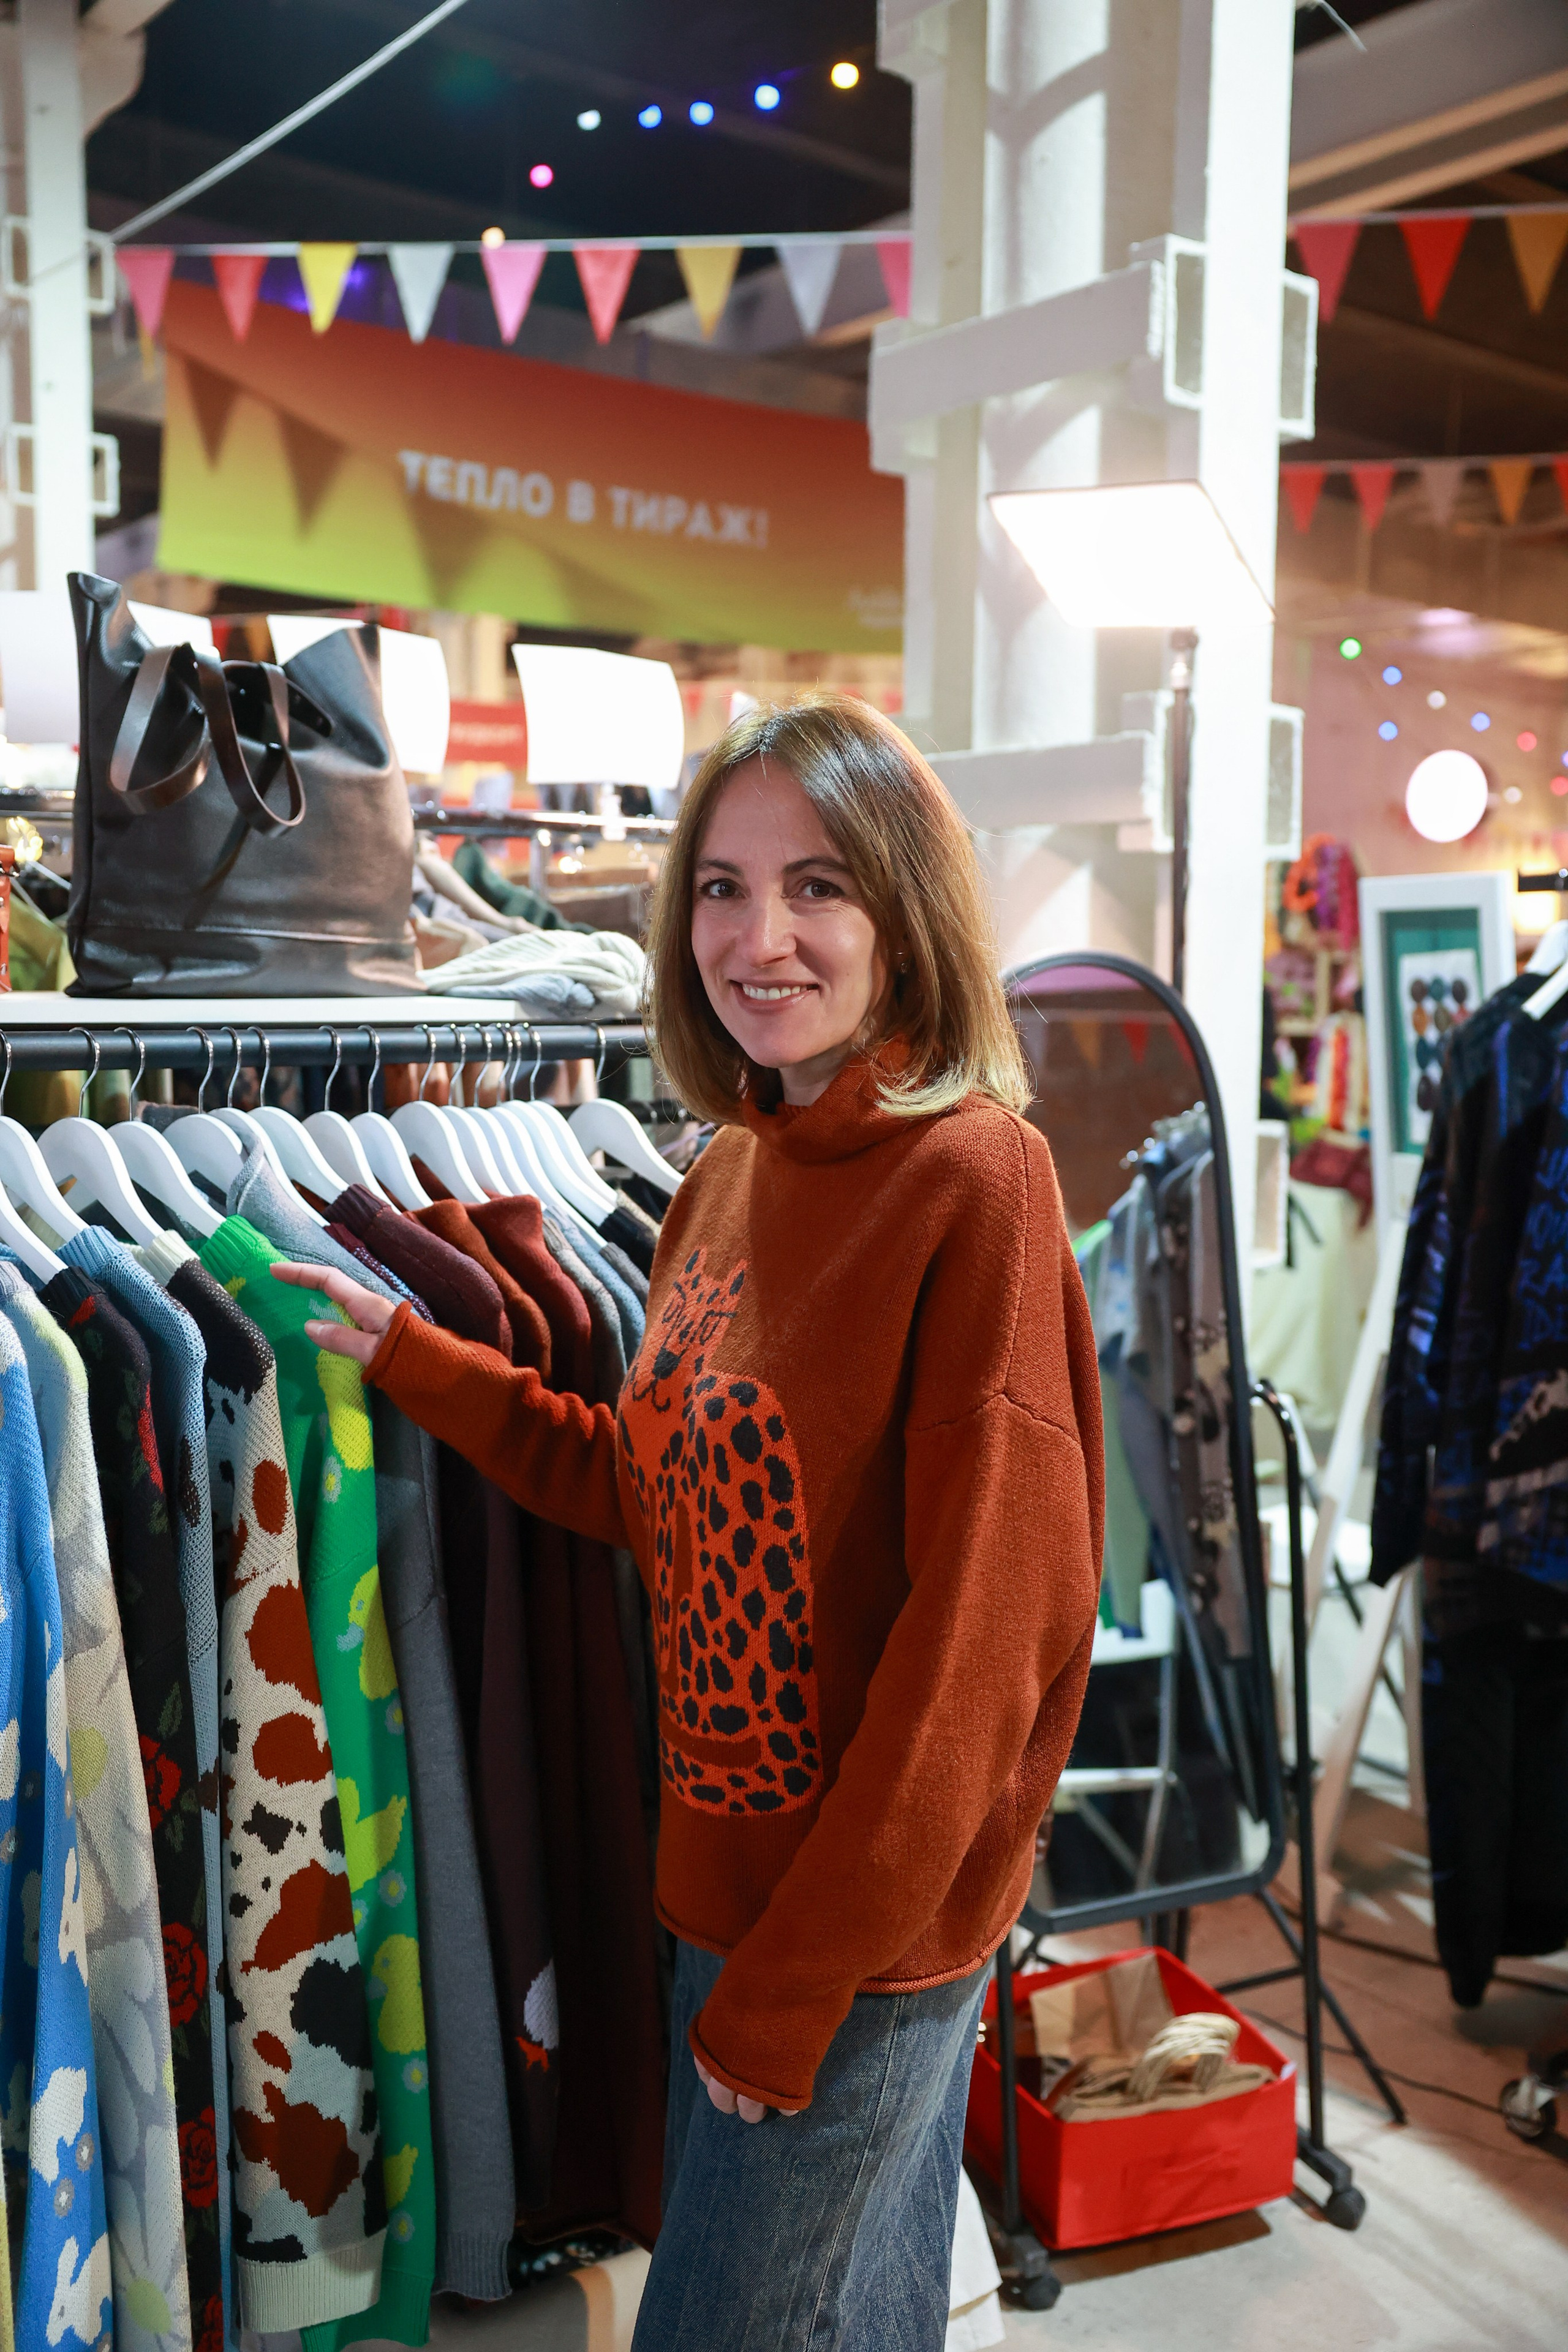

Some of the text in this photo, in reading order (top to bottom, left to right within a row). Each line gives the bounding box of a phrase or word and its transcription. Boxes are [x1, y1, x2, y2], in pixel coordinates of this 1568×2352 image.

[398, 449, 768, 549] ТЕПЛО В ТИРАЖ!
